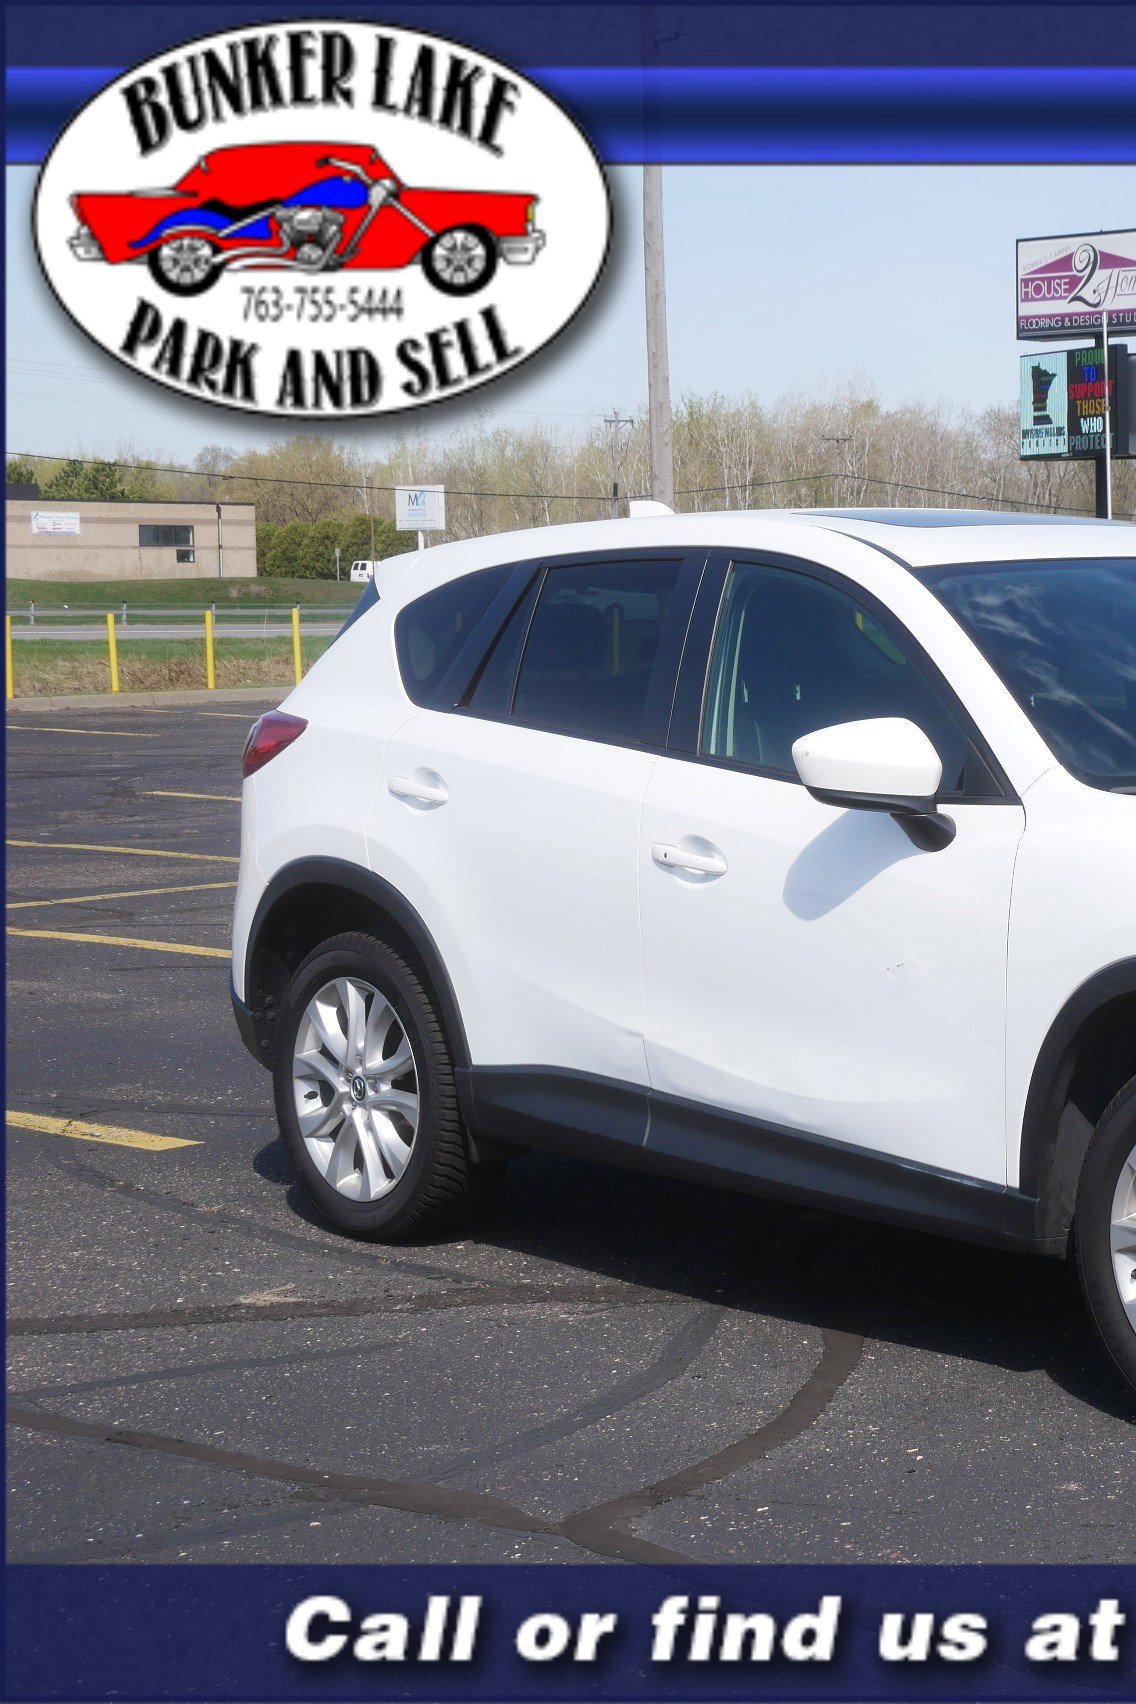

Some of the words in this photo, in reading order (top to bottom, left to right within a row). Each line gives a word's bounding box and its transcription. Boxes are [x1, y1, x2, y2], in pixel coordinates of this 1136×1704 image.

[1021, 278, 1070, 299] HOUSE
[1067, 243, 1101, 309] 2
[1020, 315, 1062, 330] FLOORING
[1064, 317, 1071, 327] &
[1082, 366, 1097, 383] TO
[1080, 416, 1104, 434] WHO
